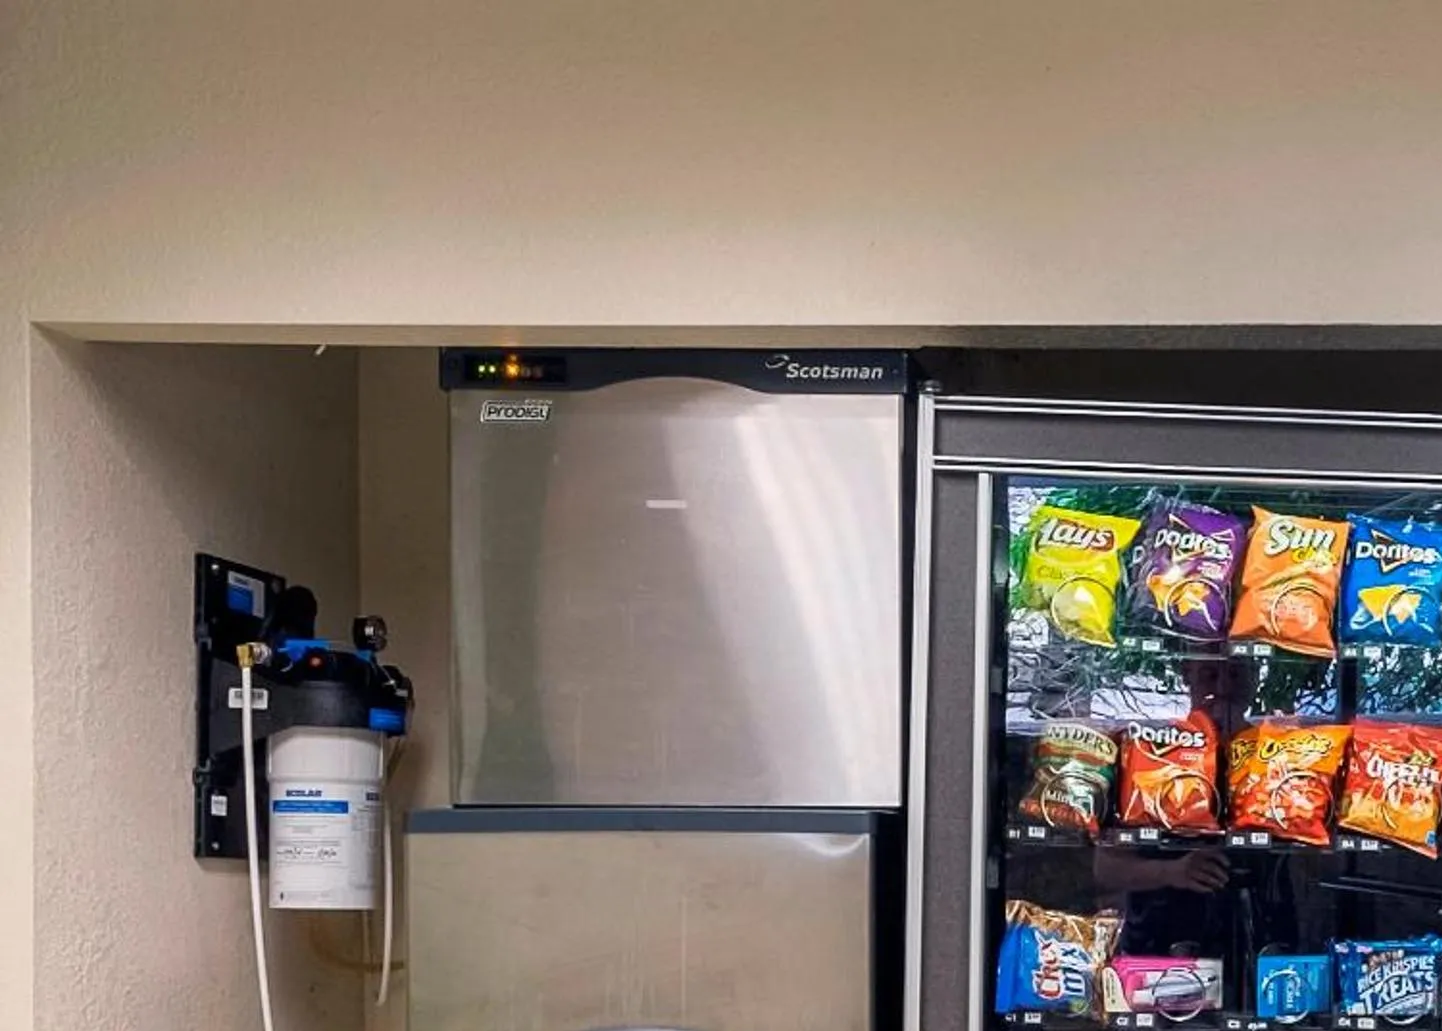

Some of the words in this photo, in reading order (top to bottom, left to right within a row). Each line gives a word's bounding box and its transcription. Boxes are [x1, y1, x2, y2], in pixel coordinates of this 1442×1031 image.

[785, 361, 884, 380] Scotsman
[1264, 517, 1337, 557] Sun
[1127, 720, 1205, 748] Doritos
[1357, 968, 1384, 992] RICE
[1359, 972, 1437, 1015] TREATS
